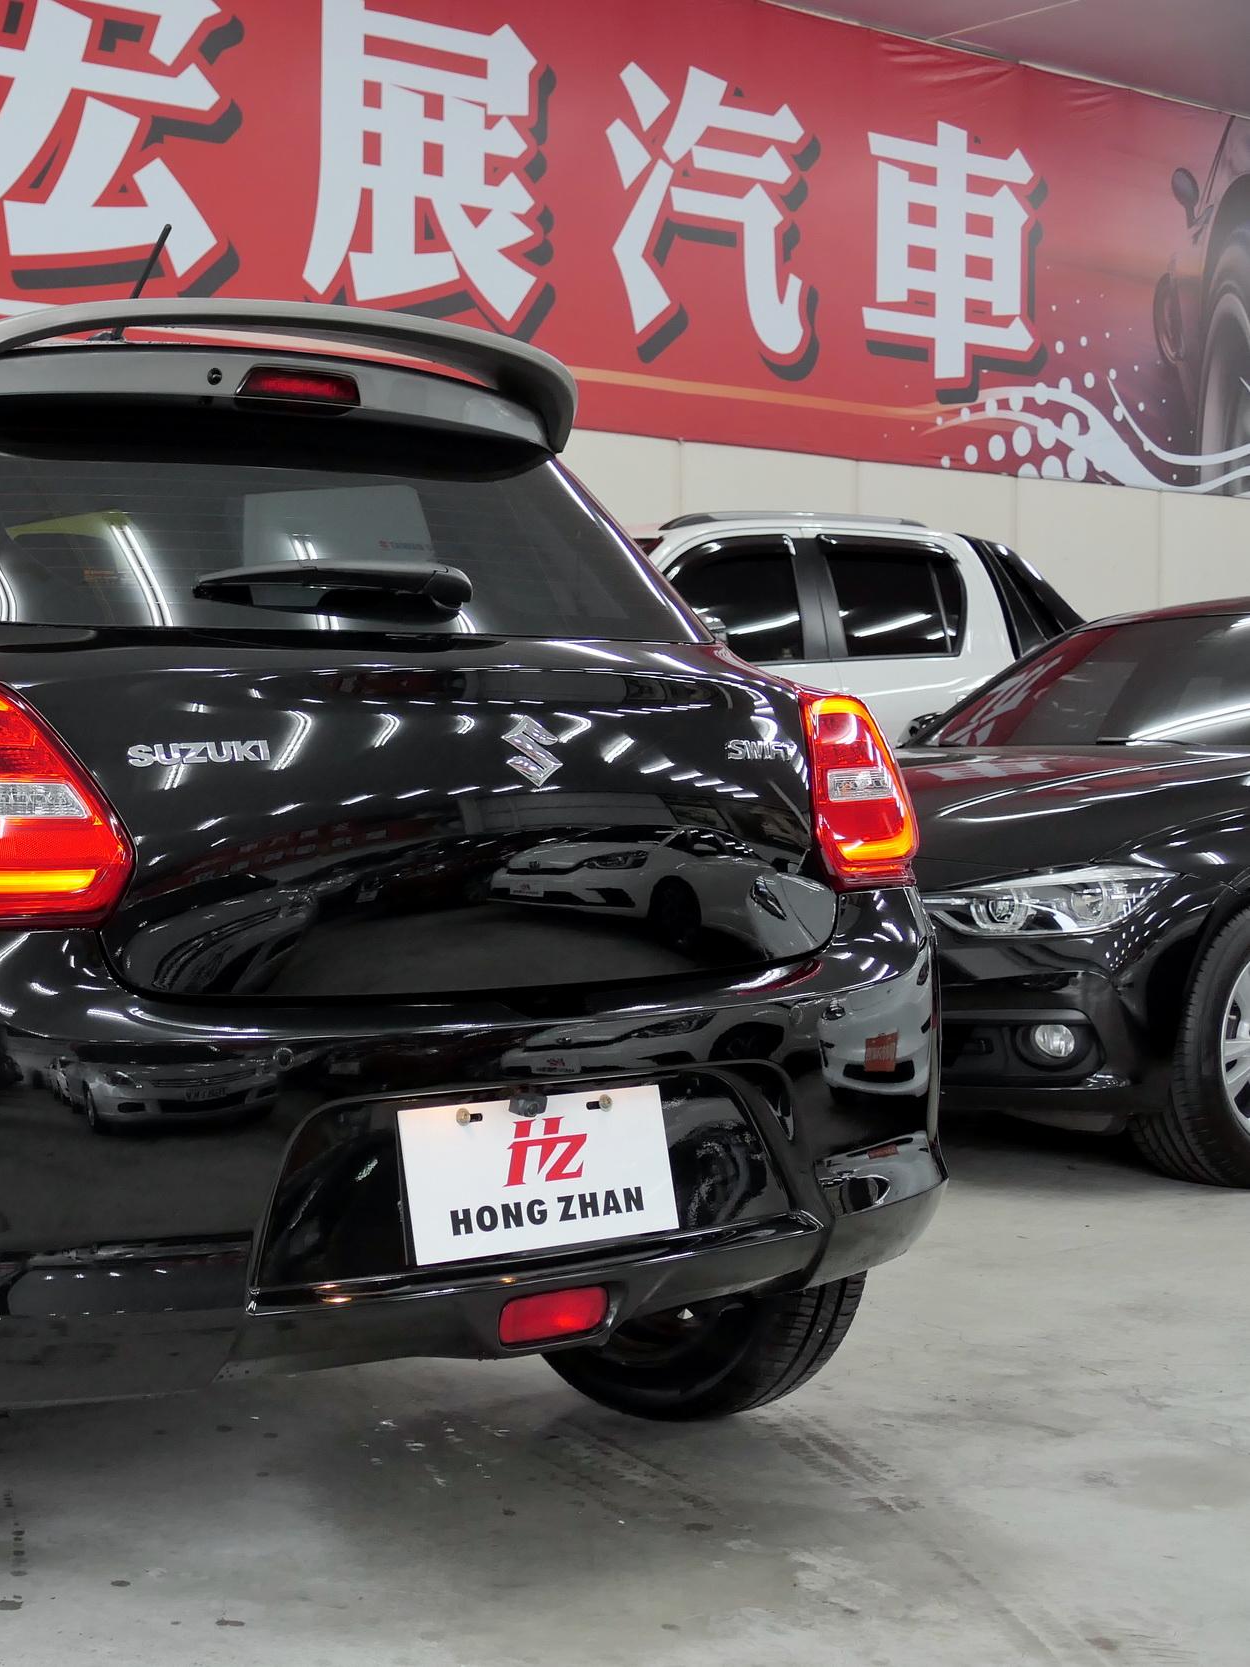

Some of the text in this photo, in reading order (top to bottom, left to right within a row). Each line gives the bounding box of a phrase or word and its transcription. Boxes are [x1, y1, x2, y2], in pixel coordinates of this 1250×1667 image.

[127, 739, 272, 768] SUZUKI
[726, 738, 798, 763] SWIFT
[449, 1185, 646, 1237] HONG ZHAN
